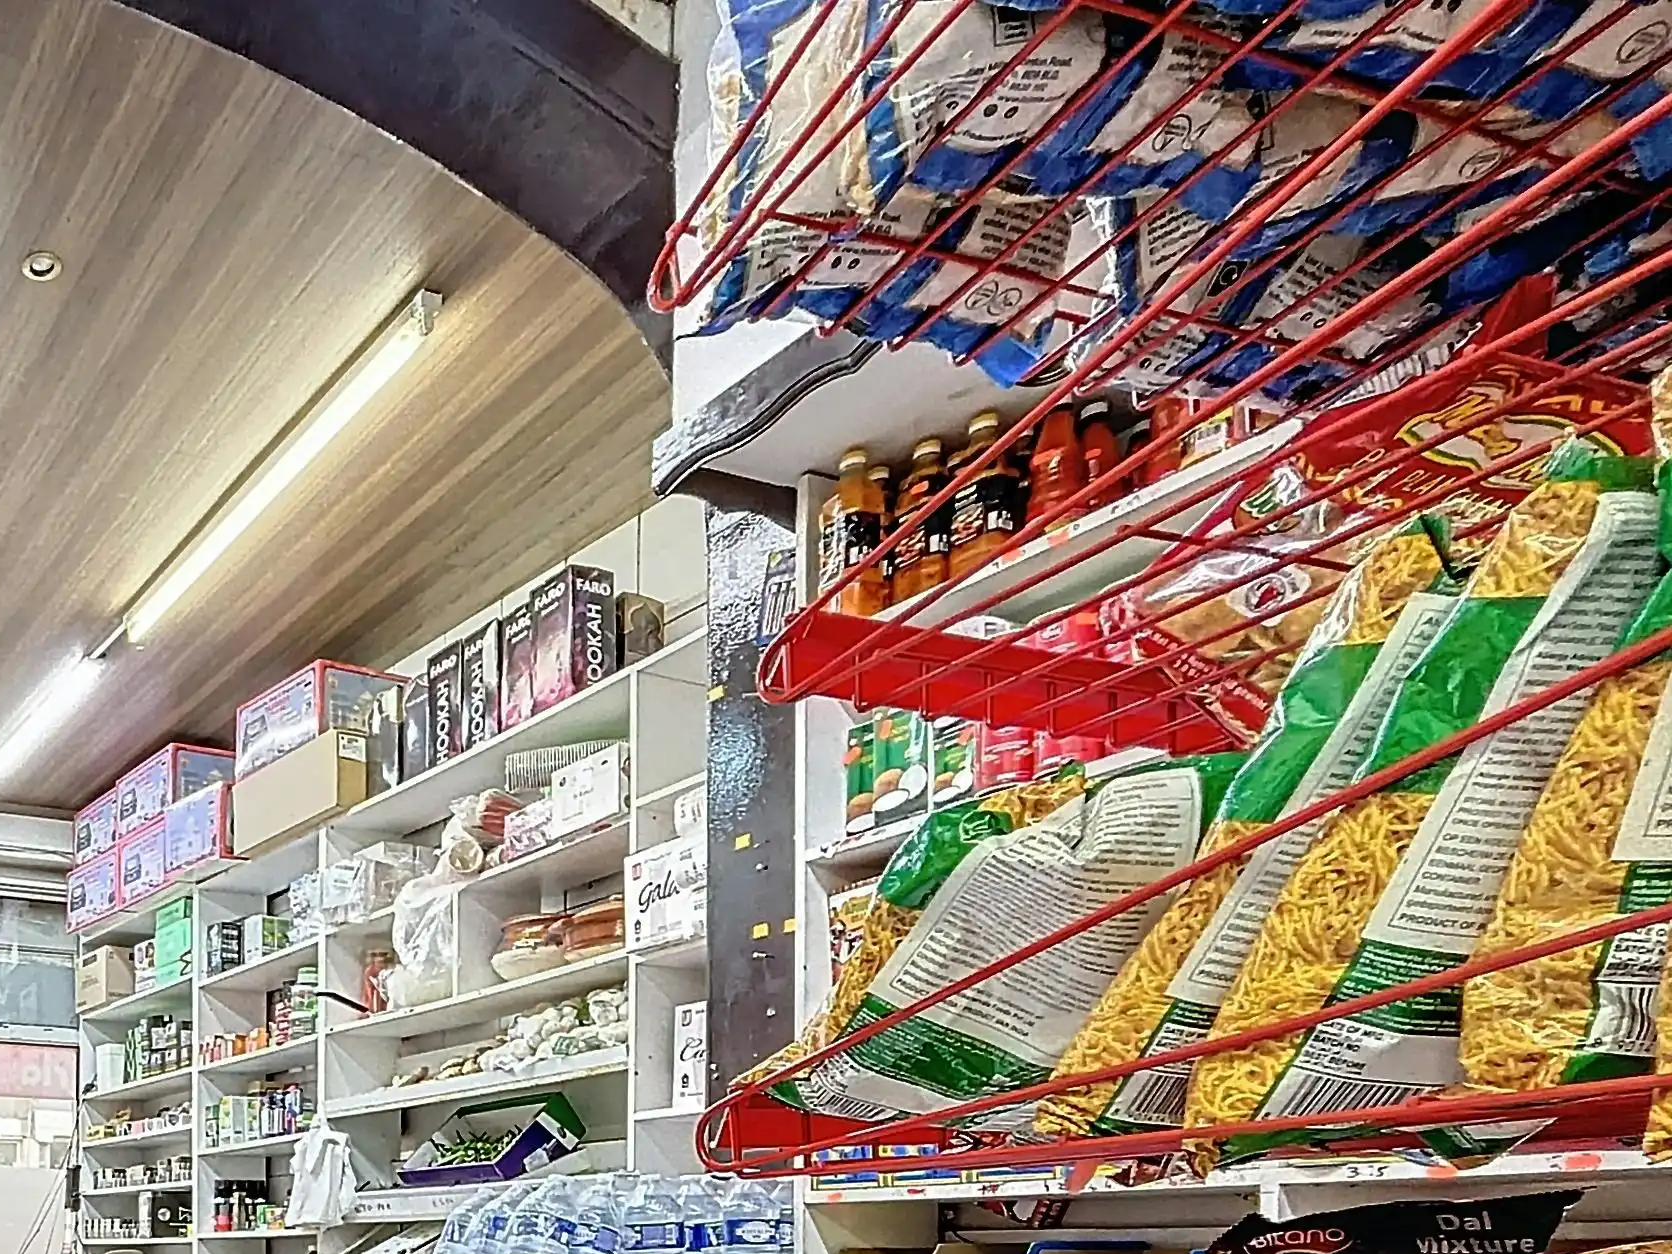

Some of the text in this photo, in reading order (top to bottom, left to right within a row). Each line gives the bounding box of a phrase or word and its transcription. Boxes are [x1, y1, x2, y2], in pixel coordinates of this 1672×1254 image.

[533, 580, 567, 611] FARO
[575, 577, 612, 597] FARO
[464, 639, 484, 658] FAR
[429, 655, 458, 680] FARO
[436, 683, 451, 765] HOOKAH
[1398, 911, 1459, 929] PRODUCT
[1435, 1210, 1493, 1231] Dal
